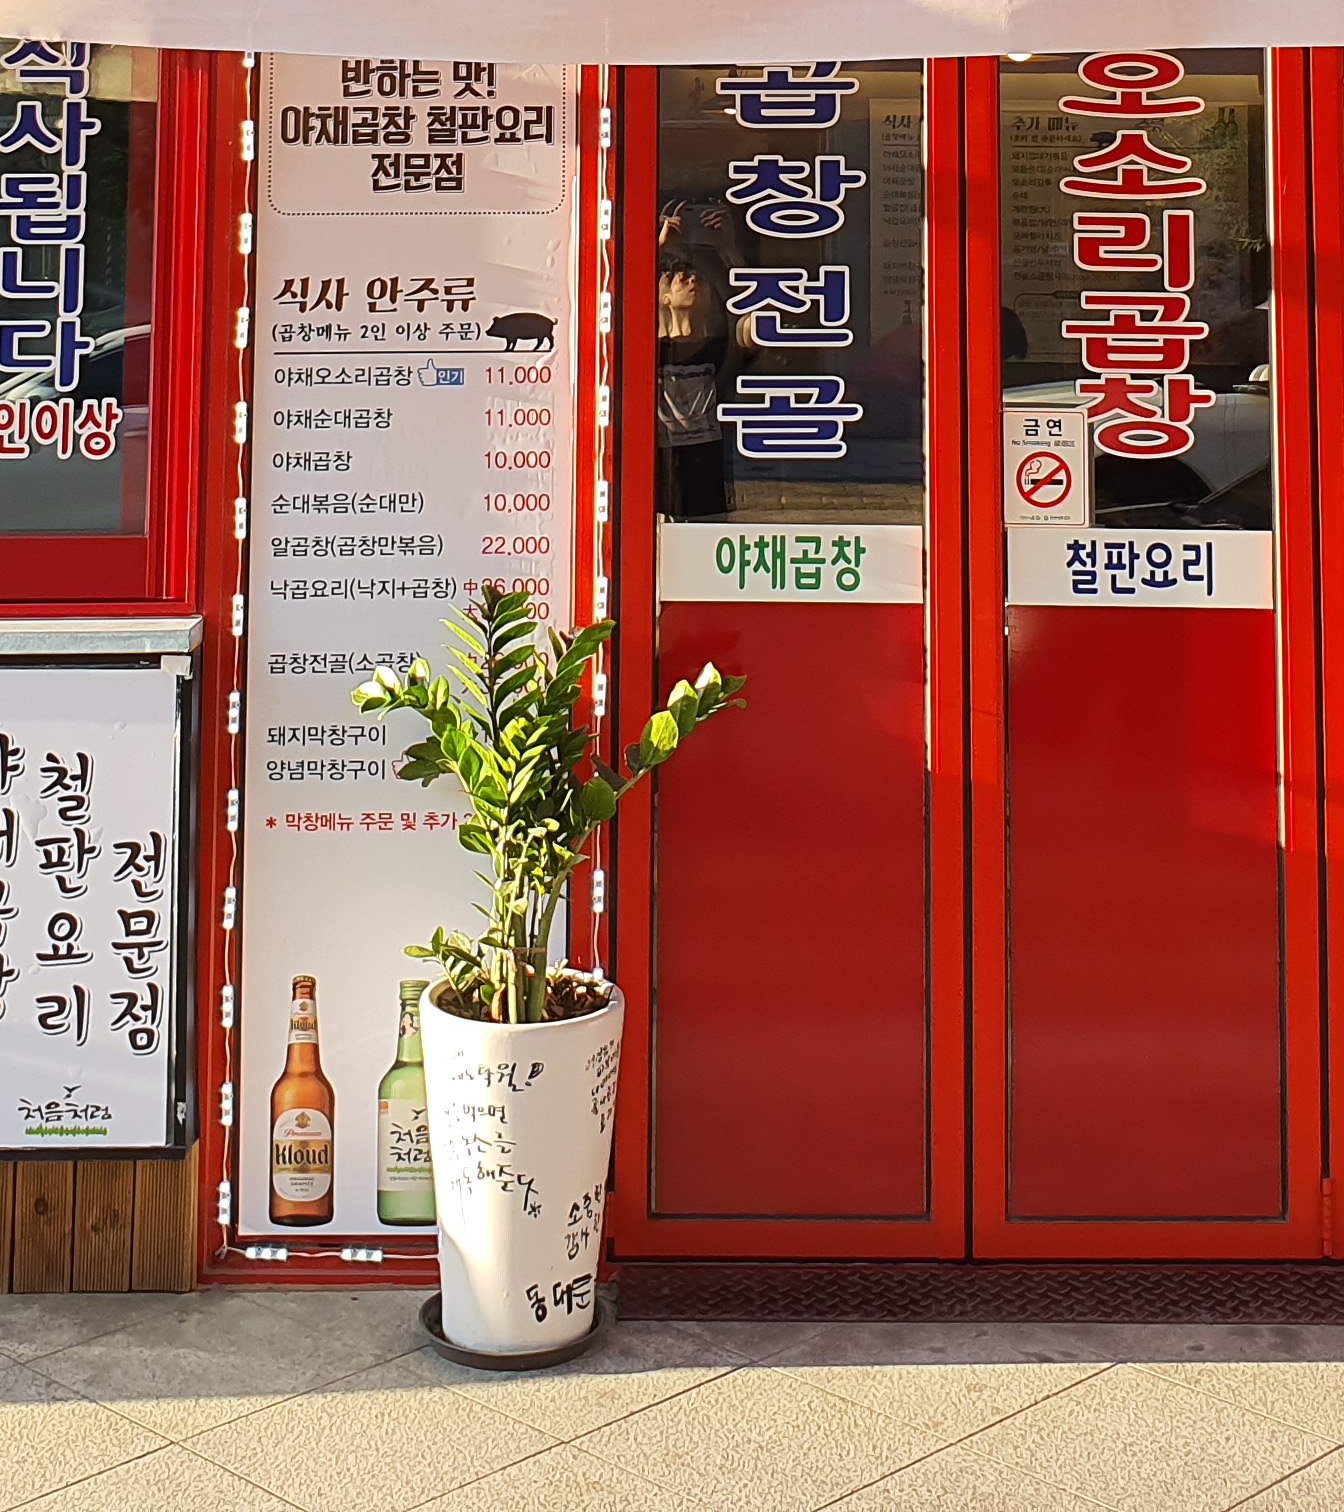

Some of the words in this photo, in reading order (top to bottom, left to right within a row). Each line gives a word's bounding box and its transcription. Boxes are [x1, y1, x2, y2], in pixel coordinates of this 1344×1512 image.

[341, 59, 442, 99] 반하는
[452, 61, 498, 99] 맛!
[280, 105, 417, 147] 야채곱창
[426, 105, 555, 146] 철판요리
[370, 152, 466, 193] 전문점
[1057, 50, 1218, 460] 오소리곱창
[272, 275, 350, 314] 식사
[365, 275, 479, 314] 안주류
[271, 322, 353, 343] (곱창메뉴
[359, 322, 387, 342] 2인
[394, 321, 432, 342] 이상
[437, 322, 482, 343] 주문)
[272, 366, 414, 388] 야채오소리곱창
[437, 368, 465, 386] 인기
[484, 366, 553, 386] 11.000
[272, 408, 394, 430] 야채순대곱창
[483, 408, 552, 428] 11.000
[1022, 417, 1064, 438] 금연
[271, 450, 353, 473] 야채곱창
[482, 450, 552, 471] 10.000
[270, 492, 425, 516] 순대볶음(순대만)
[482, 493, 551, 514] 10.000
[270, 535, 445, 558] 알곱창(곱창만볶음)
[481, 536, 551, 558] 22.000
[714, 532, 868, 593] 야채곱창
[1063, 538, 1217, 597] 철판요리
[269, 577, 458, 601] 낙곱요리(낙지+곱창)
[266, 724, 387, 747] 돼지막창구이
[265, 758, 387, 782] 양념막창구이
[284, 812, 355, 832] 막창메뉴
[358, 812, 394, 831] 주문
[400, 812, 418, 831] 및
[421, 811, 458, 831] 추가
[33, 750, 102, 1047] 철판요리
[108, 830, 169, 1056] 전문점
[290, 1017, 317, 1033] Kloud
[17, 1096, 114, 1125] 처음처럼
[274, 1142, 331, 1167] Kloud
